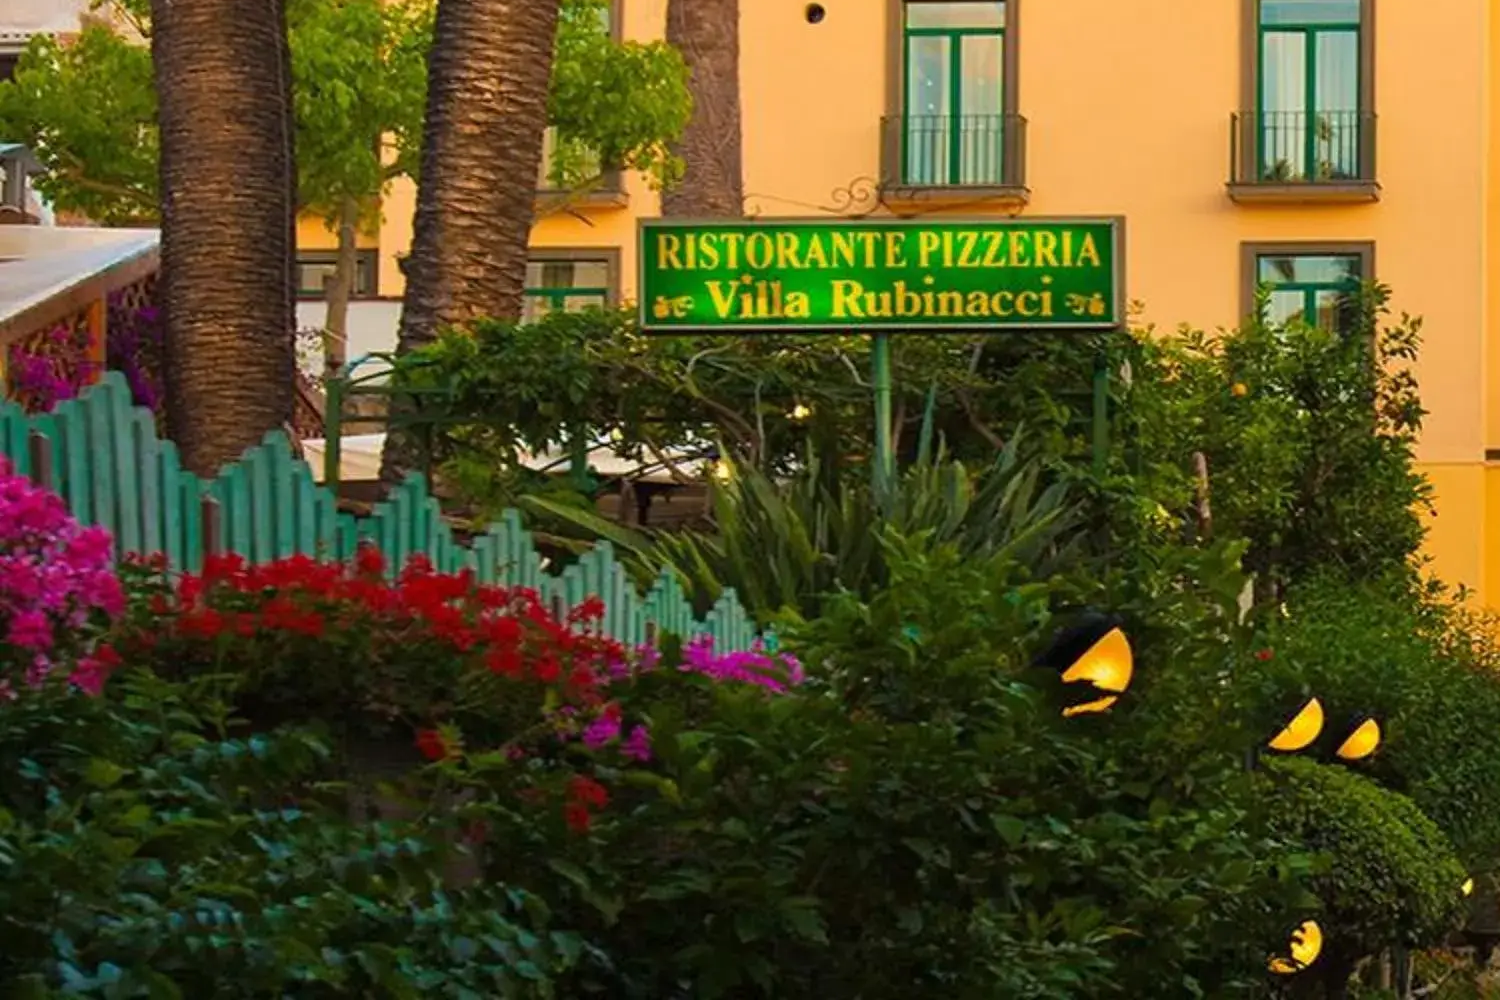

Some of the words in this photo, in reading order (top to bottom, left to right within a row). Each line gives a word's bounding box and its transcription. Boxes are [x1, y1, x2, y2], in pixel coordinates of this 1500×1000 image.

[656, 230, 906, 271] RISTORANTE
[918, 229, 1100, 268] PIZZERIA
[705, 274, 811, 319] Villa
[829, 274, 1053, 319] Rubinacci
